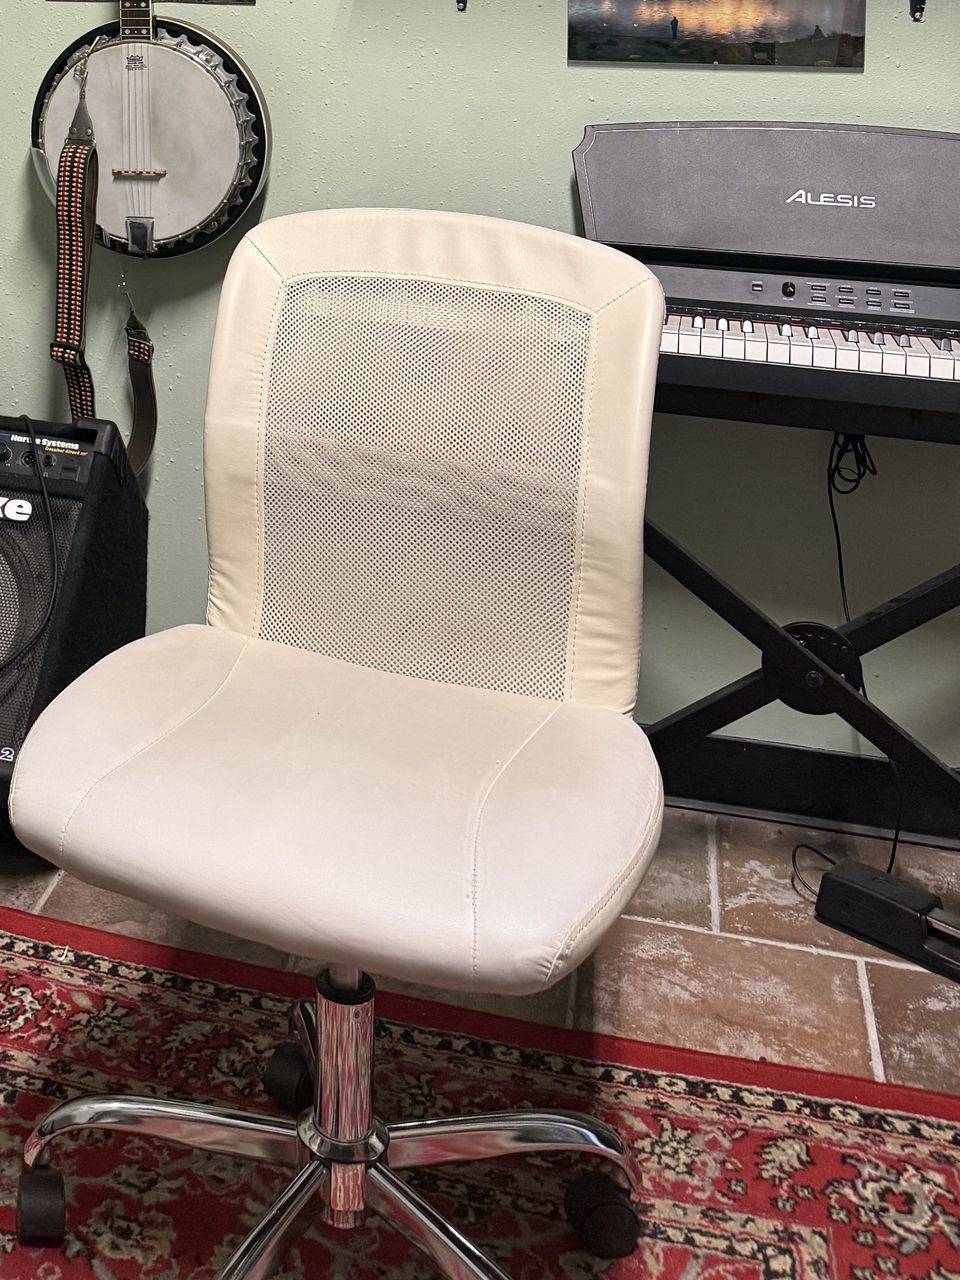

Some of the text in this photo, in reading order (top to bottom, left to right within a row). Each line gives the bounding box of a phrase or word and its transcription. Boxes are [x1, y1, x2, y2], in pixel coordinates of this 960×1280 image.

[785, 188, 876, 208] ALESIS
[10, 434, 80, 450] Harte Systems
